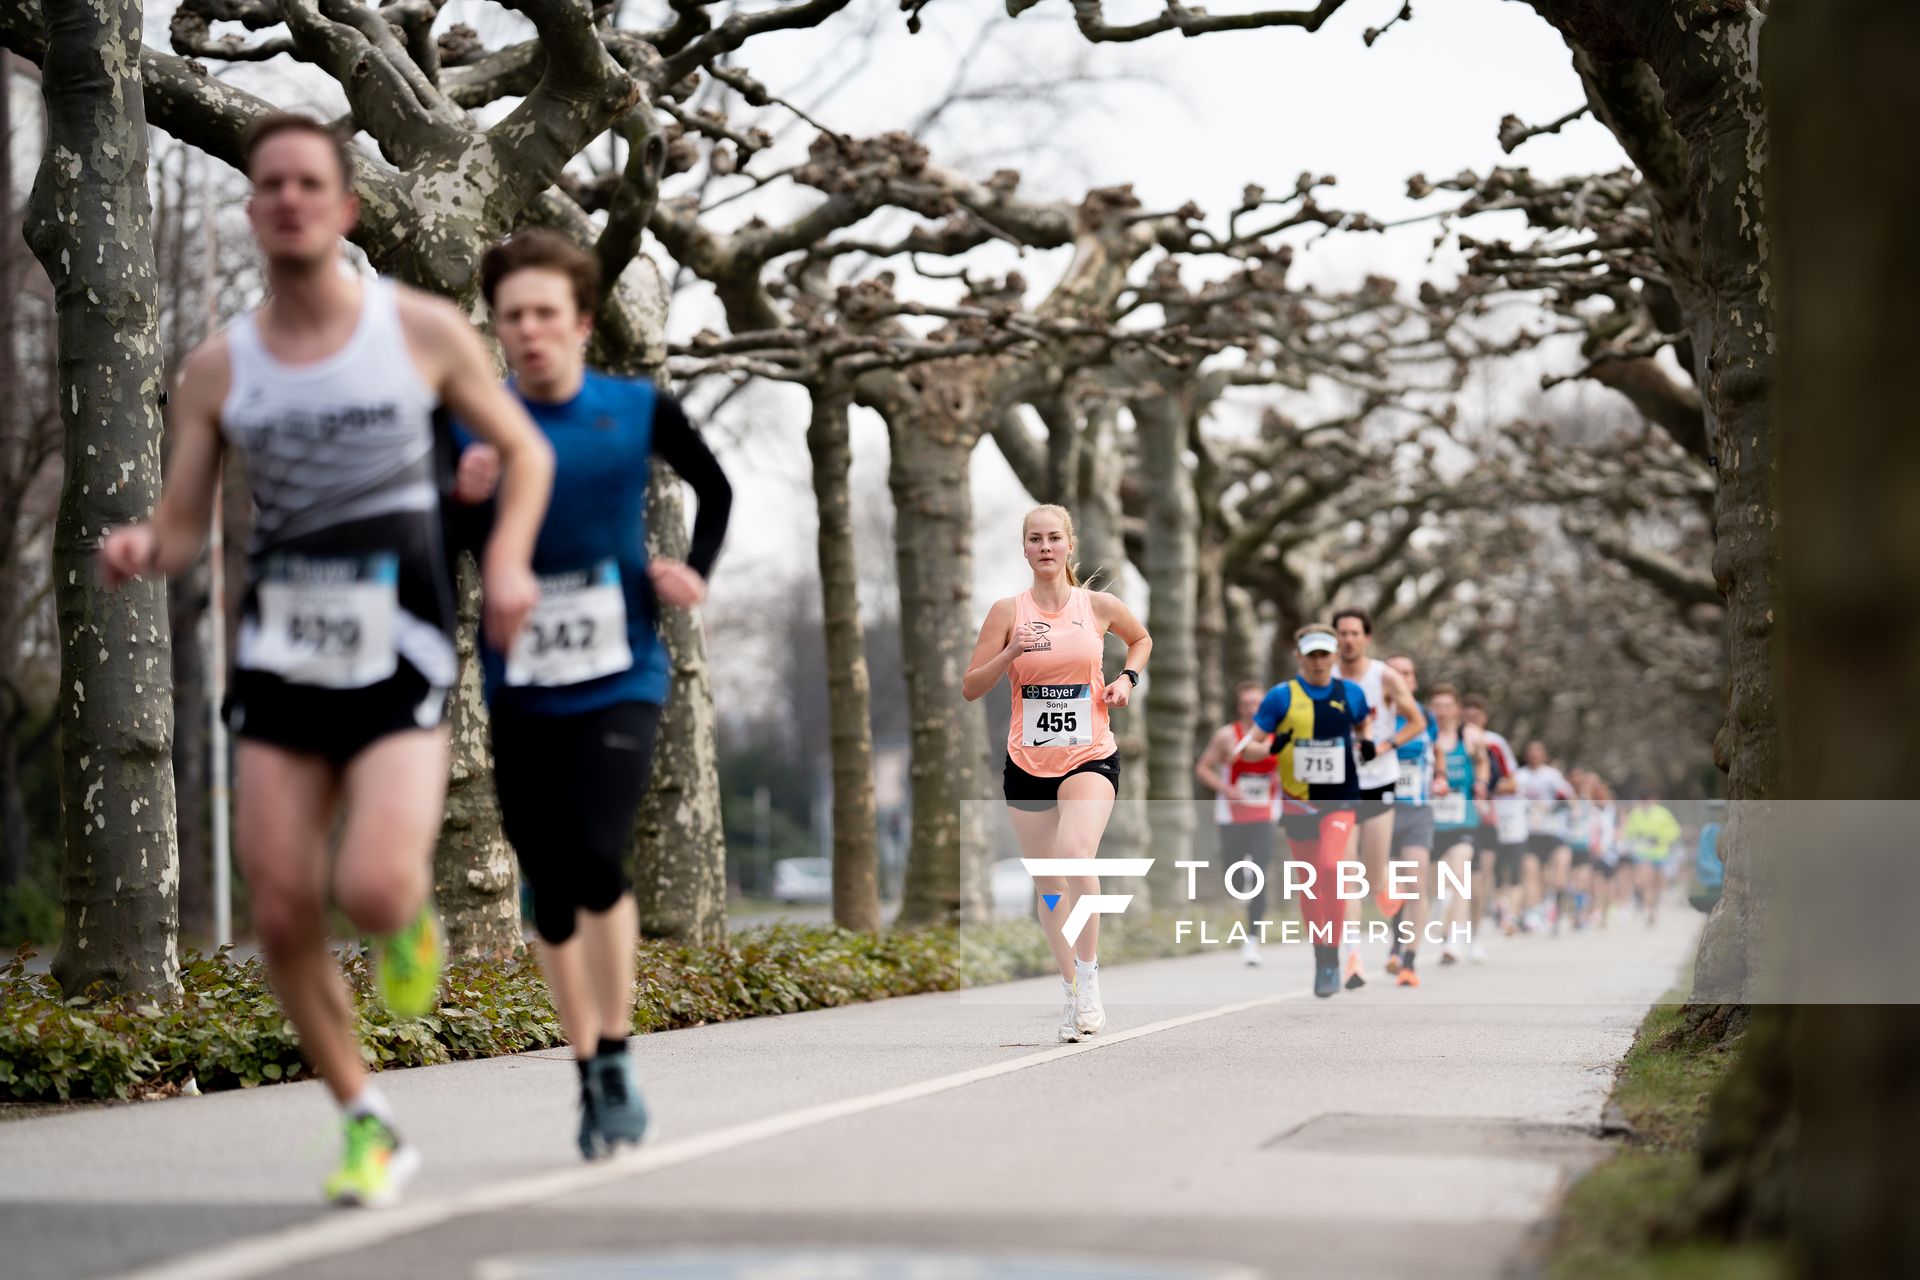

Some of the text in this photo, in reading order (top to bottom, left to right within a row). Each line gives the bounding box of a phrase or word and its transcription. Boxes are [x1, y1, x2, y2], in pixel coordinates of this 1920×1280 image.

[1041, 686, 1075, 698] Bayer
[1046, 701, 1068, 709] Sonja
[1036, 711, 1077, 733] 455
[1304, 757, 1334, 772] 715
